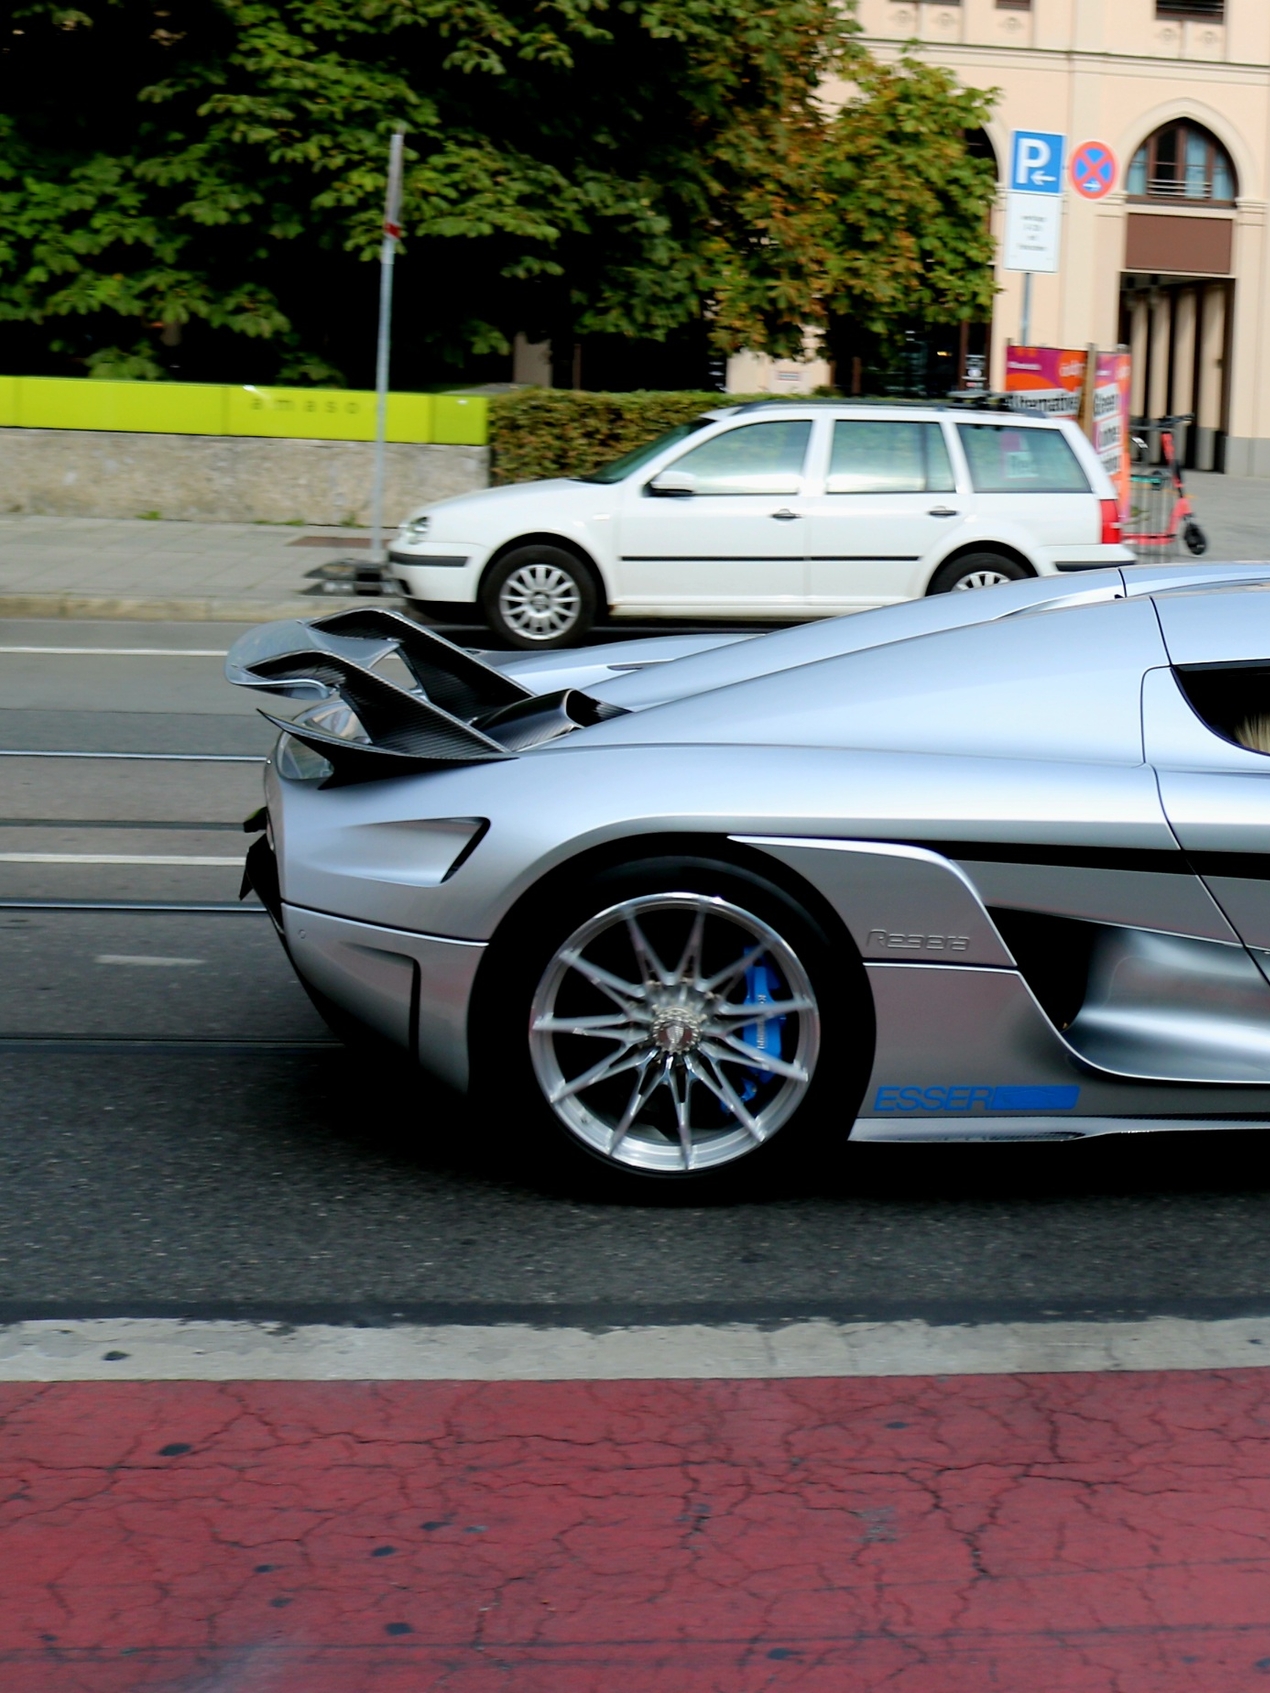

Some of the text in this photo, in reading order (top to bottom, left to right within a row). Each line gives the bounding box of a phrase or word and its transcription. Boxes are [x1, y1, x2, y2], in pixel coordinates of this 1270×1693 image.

[1015, 137, 1051, 184] P
[866, 929, 970, 951] Regera
[874, 1085, 994, 1111] ESSER
